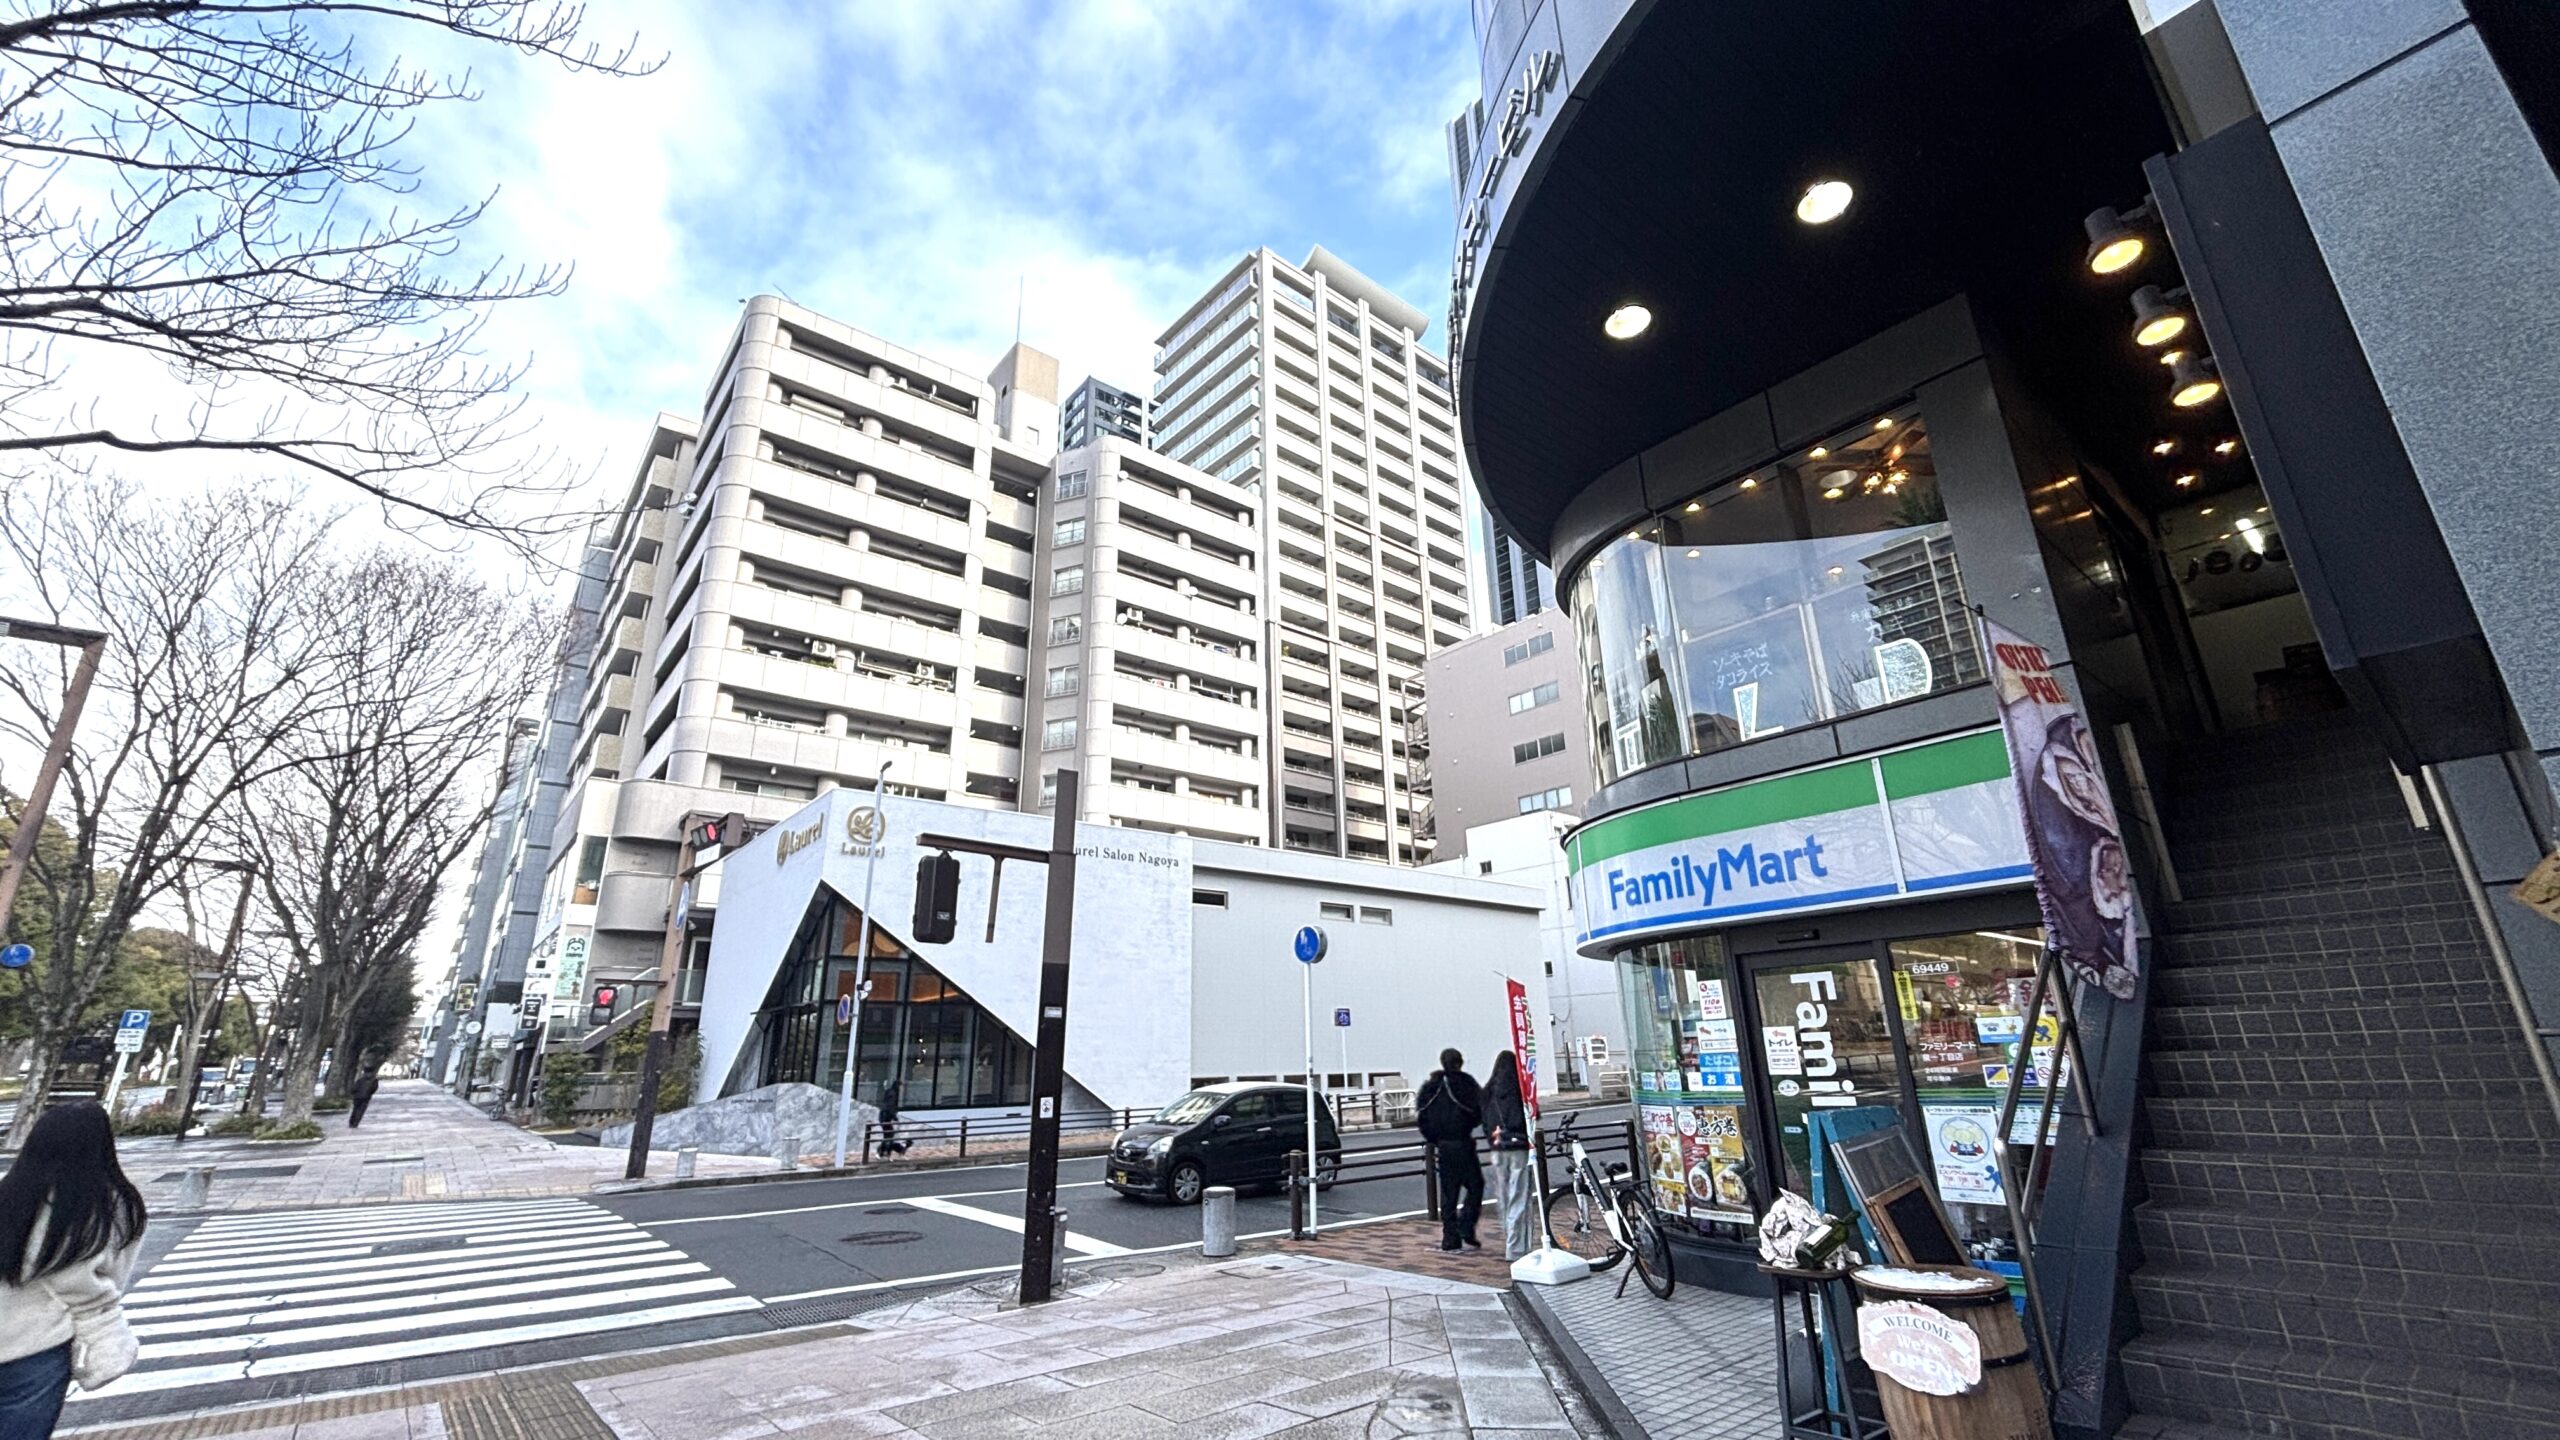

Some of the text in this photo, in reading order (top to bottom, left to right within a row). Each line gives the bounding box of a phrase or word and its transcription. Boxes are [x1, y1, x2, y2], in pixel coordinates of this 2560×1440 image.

[789, 813, 824, 855] Laurel
[1075, 846, 1180, 868] urel Salon Nagoya
[1609, 835, 1828, 910] FamilyMart
[1911, 963, 1950, 974] 69449
[126, 1012, 145, 1027] P
[1768, 1039, 1793, 1047] トイレ
[1790, 971, 1857, 1124] Famil
[1919, 1041, 1977, 1051] ファミリーマート
[1697, 1116, 1738, 1137] 恵方巻
[1883, 1316, 1954, 1343] WELCOME
[1889, 1350, 1953, 1379] OPEN
